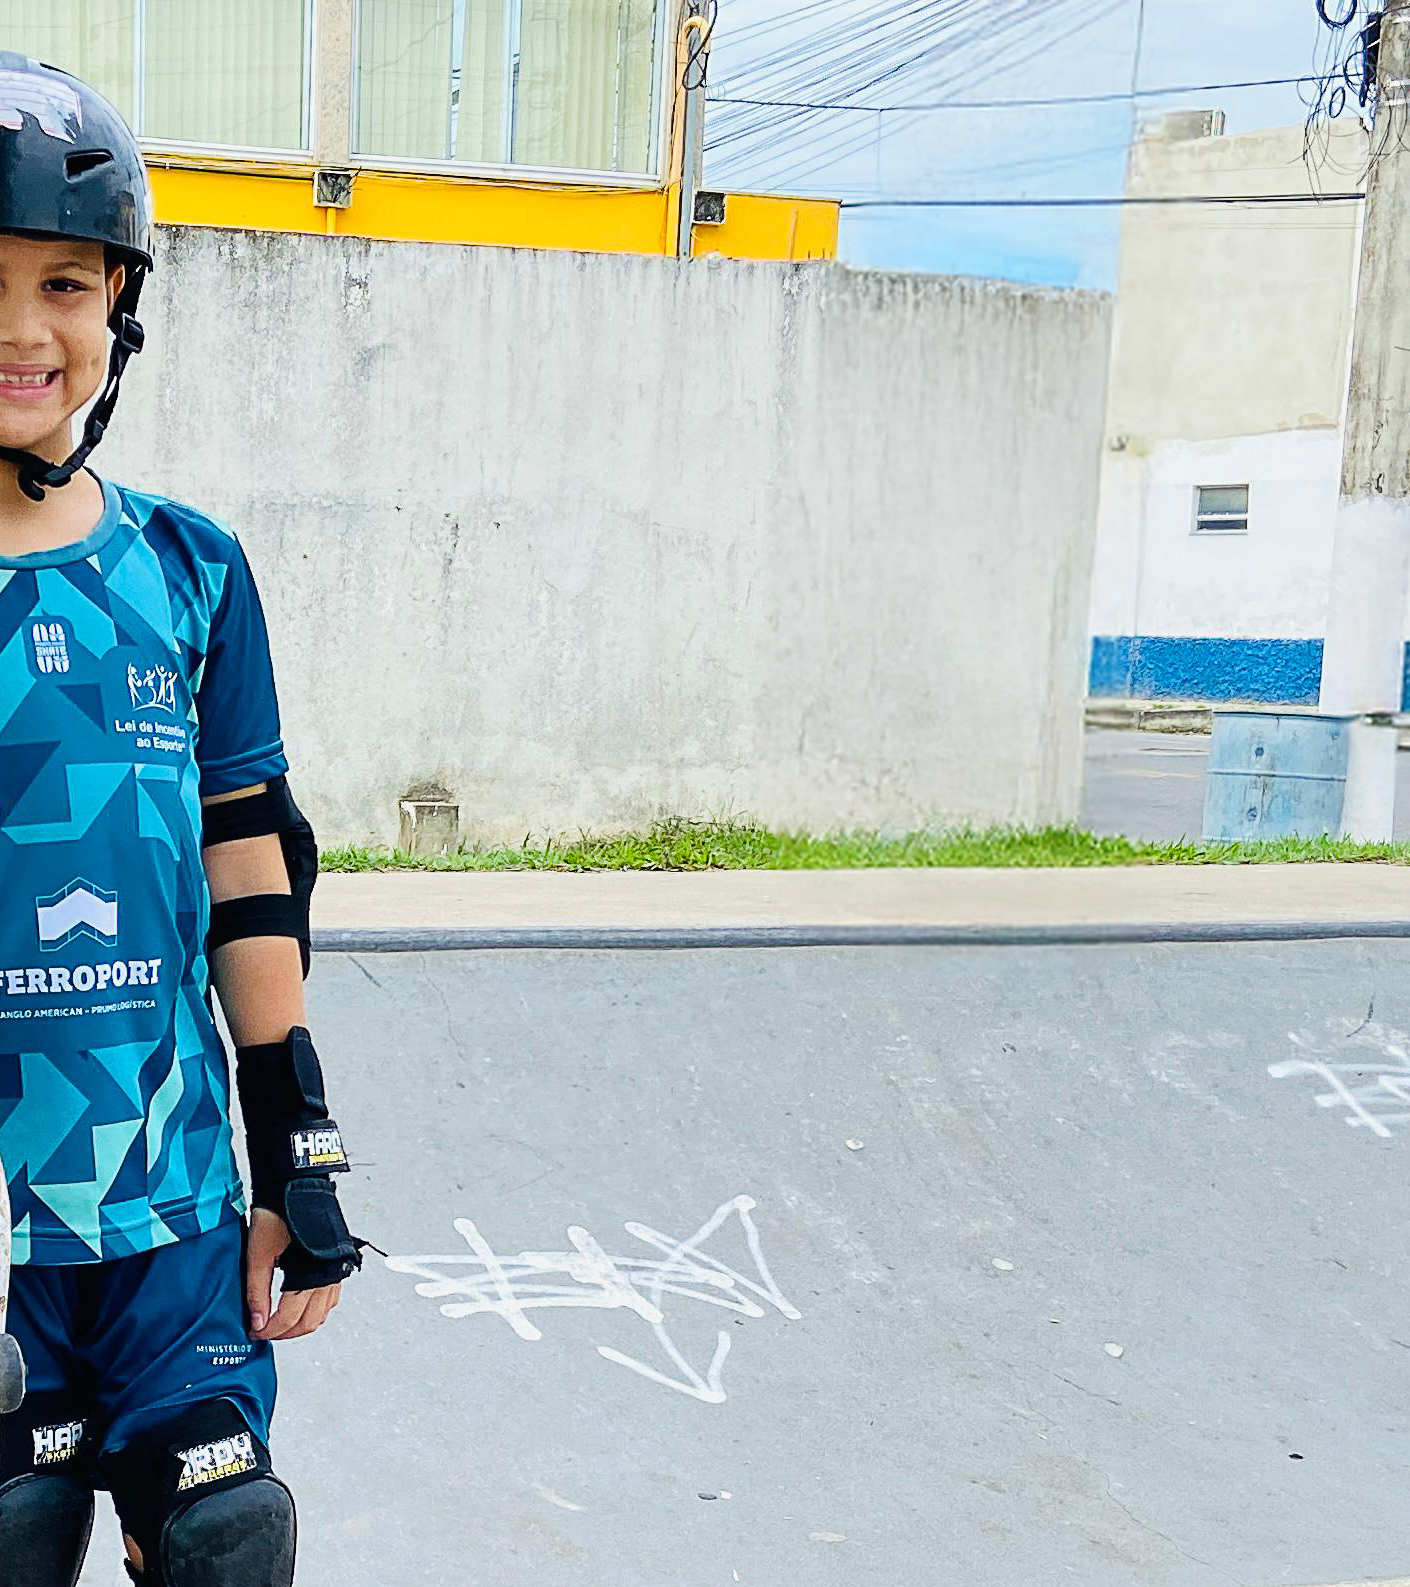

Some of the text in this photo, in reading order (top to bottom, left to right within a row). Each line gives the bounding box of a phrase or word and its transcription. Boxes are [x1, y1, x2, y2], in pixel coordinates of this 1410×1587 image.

[115, 719, 137, 733] Lei
[136, 737, 151, 748] ao
[0, 1010, 32, 1019] ANGLO
[33, 1007, 83, 1018] AMERICAN
